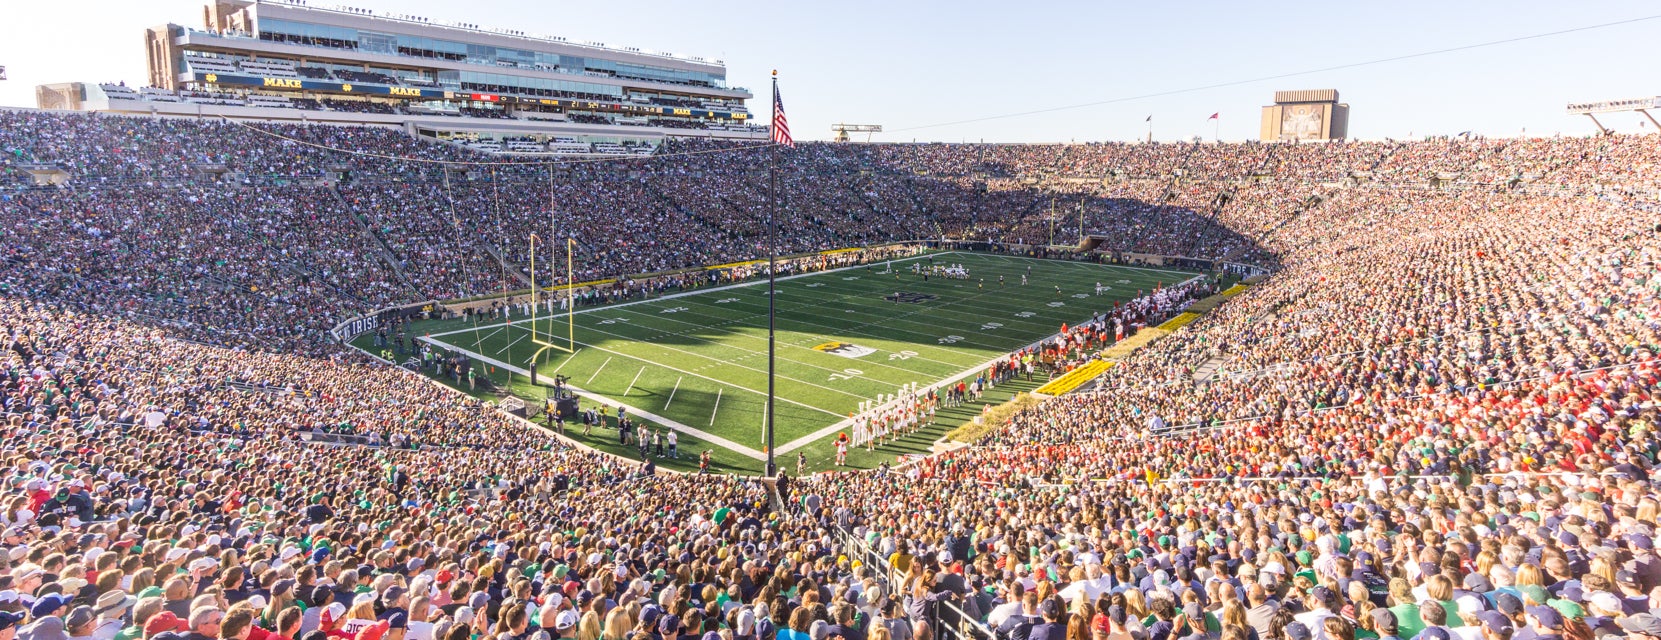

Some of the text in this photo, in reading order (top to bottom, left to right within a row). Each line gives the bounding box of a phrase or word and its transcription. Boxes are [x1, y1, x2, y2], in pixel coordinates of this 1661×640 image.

[263, 77, 302, 88] MAKE
[389, 86, 421, 96] MAKE
[352, 315, 378, 335] IRISH
[888, 350, 919, 361] 20
[829, 368, 864, 380] 10
